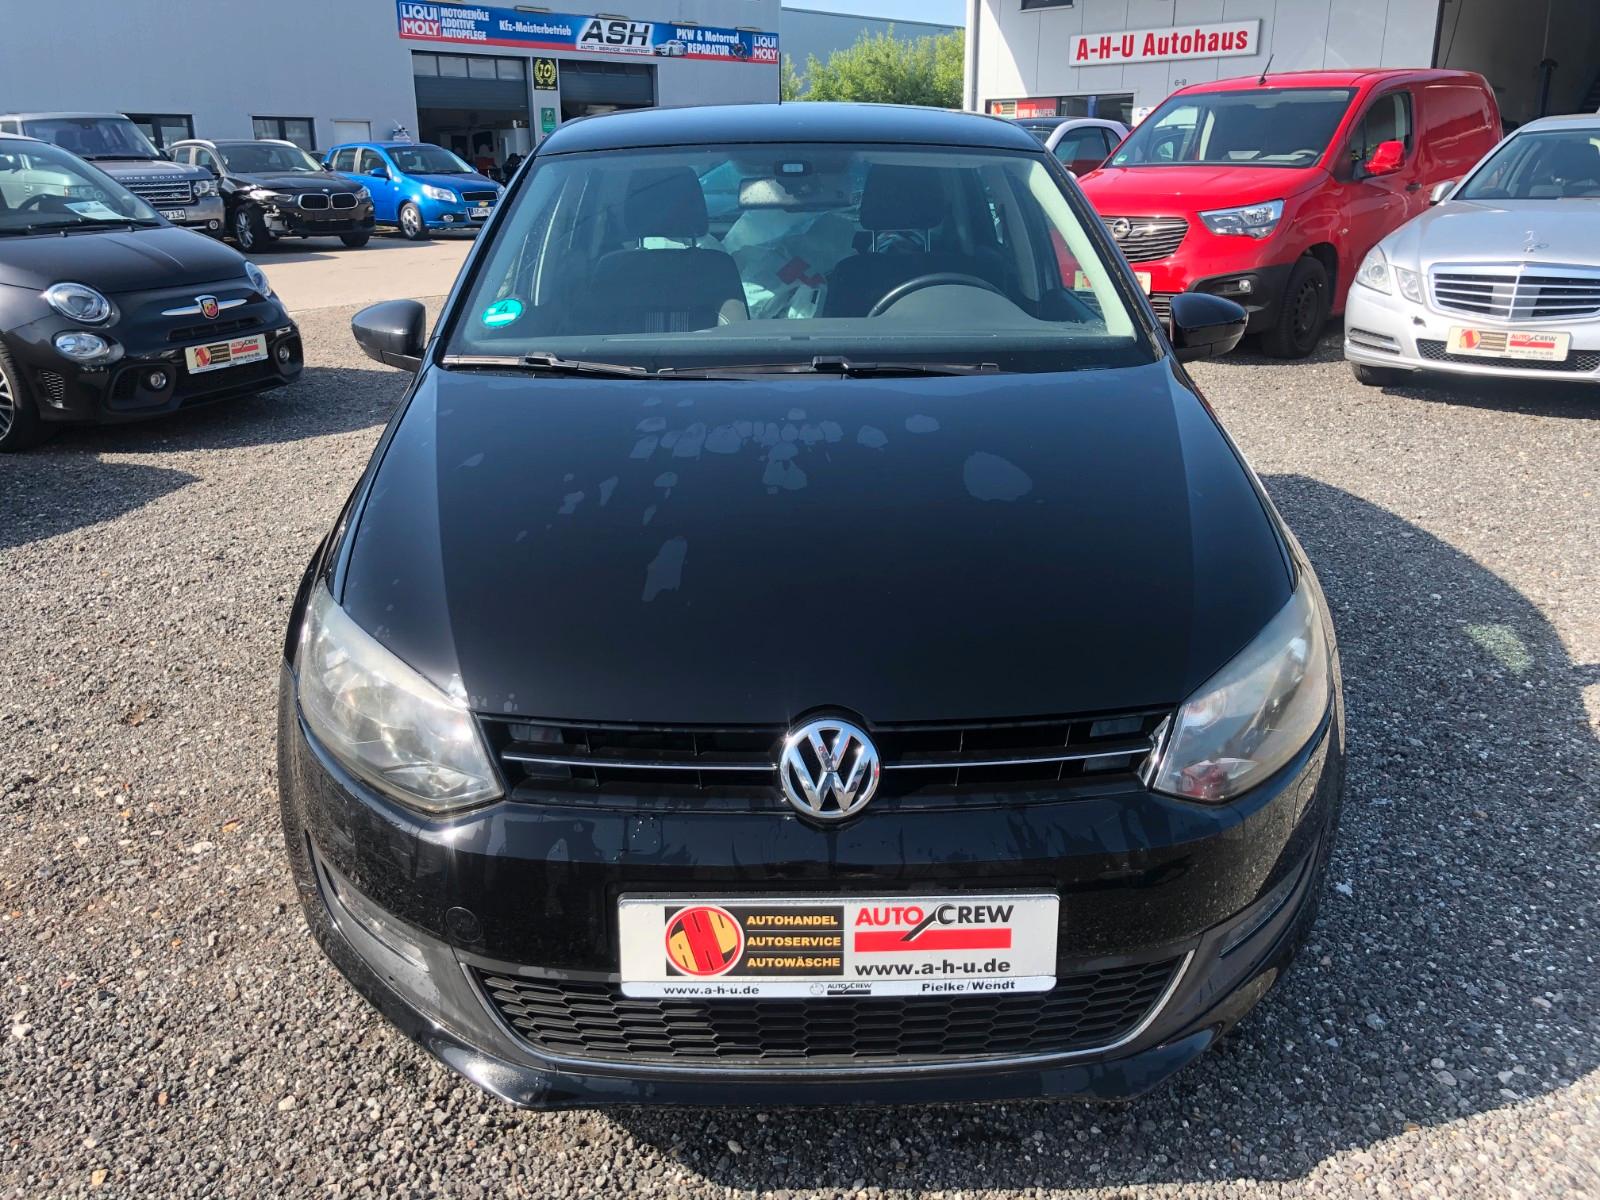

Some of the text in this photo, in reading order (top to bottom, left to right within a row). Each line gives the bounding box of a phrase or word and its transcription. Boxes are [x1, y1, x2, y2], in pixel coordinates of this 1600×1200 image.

[401, 4, 438, 20] LIQUI
[440, 7, 490, 21] MOTORENÖLE
[402, 20, 440, 36] MOLY
[441, 18, 475, 30] ADDITIVE
[499, 20, 572, 36] Kfz-Meisterbetrieb
[442, 29, 487, 41] AUTOPFLEGE
[581, 20, 649, 46] ASH
[676, 28, 740, 44] PKW & Motorrad
[754, 35, 777, 48] LIQUI
[1076, 29, 1248, 61] A-H-U Autohaus
[687, 43, 730, 56] REPARATUR
[753, 48, 777, 61] MOLY
[539, 64, 551, 77] 10
[498, 301, 509, 313] 4
[746, 915, 839, 926] AUTOHANDEL
[855, 903, 1015, 926] AUTO CREW
[746, 936, 842, 947] AUTOSERVICE
[746, 956, 841, 967] AUTOWÄSCHE
[854, 958, 1012, 976] www.a-h-u.de
[663, 985, 760, 996] www.a-h-u.de
[921, 980, 1016, 993] Pielke/Wendt
